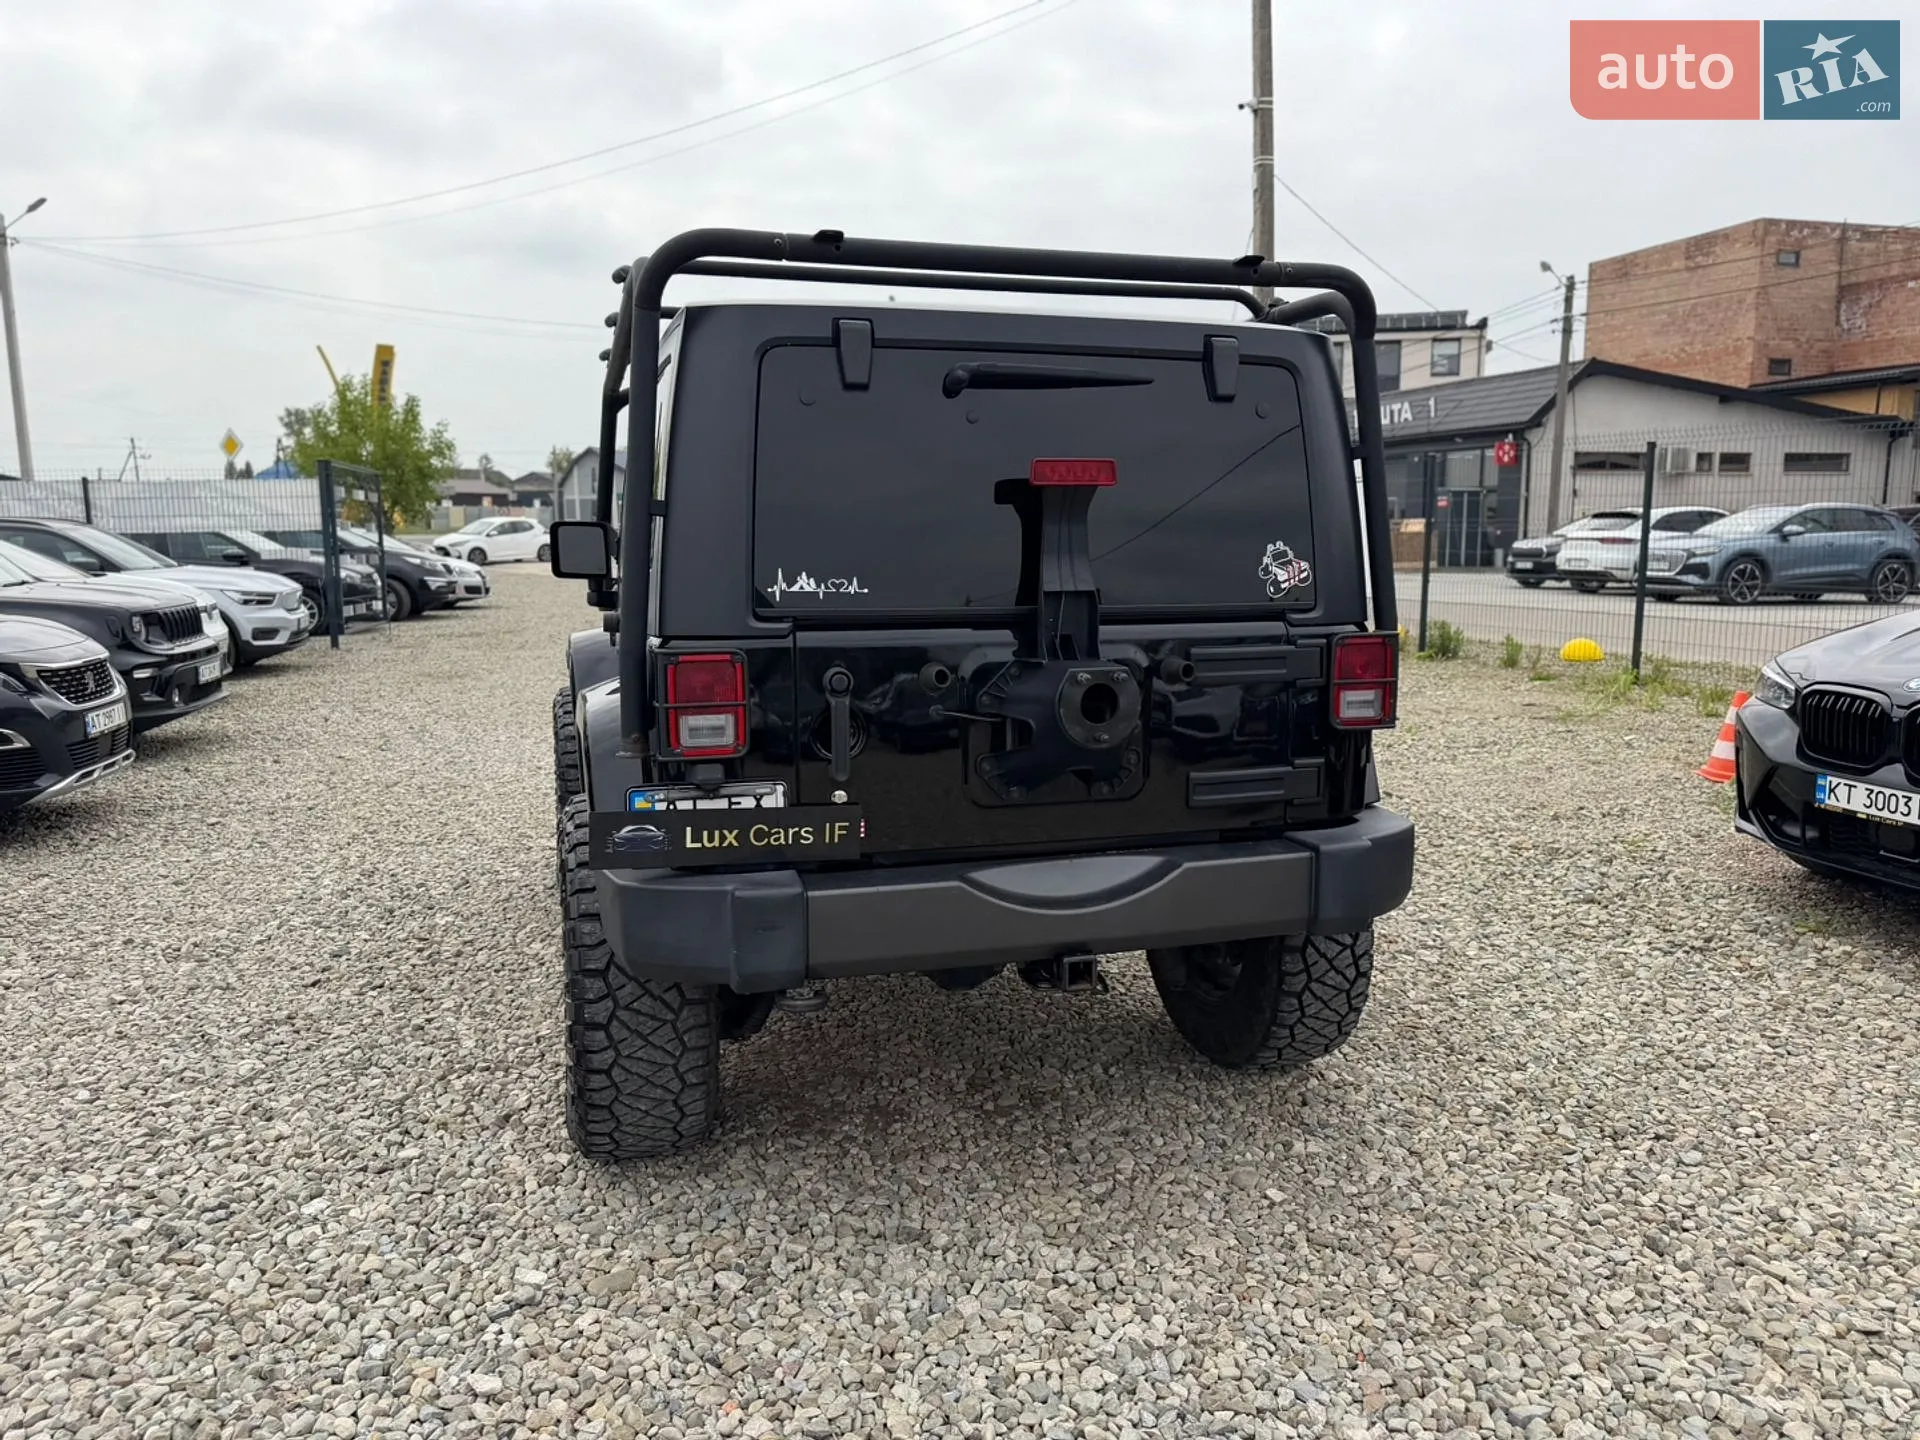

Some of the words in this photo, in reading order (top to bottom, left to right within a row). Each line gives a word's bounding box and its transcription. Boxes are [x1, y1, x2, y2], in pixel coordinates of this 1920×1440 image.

[1428, 397, 1435, 418] 1
[1828, 780, 1857, 804] KT
[1863, 787, 1912, 817] 3003
[685, 826, 739, 848] Lux
[750, 824, 814, 845] Cars
[825, 822, 849, 844] IF
